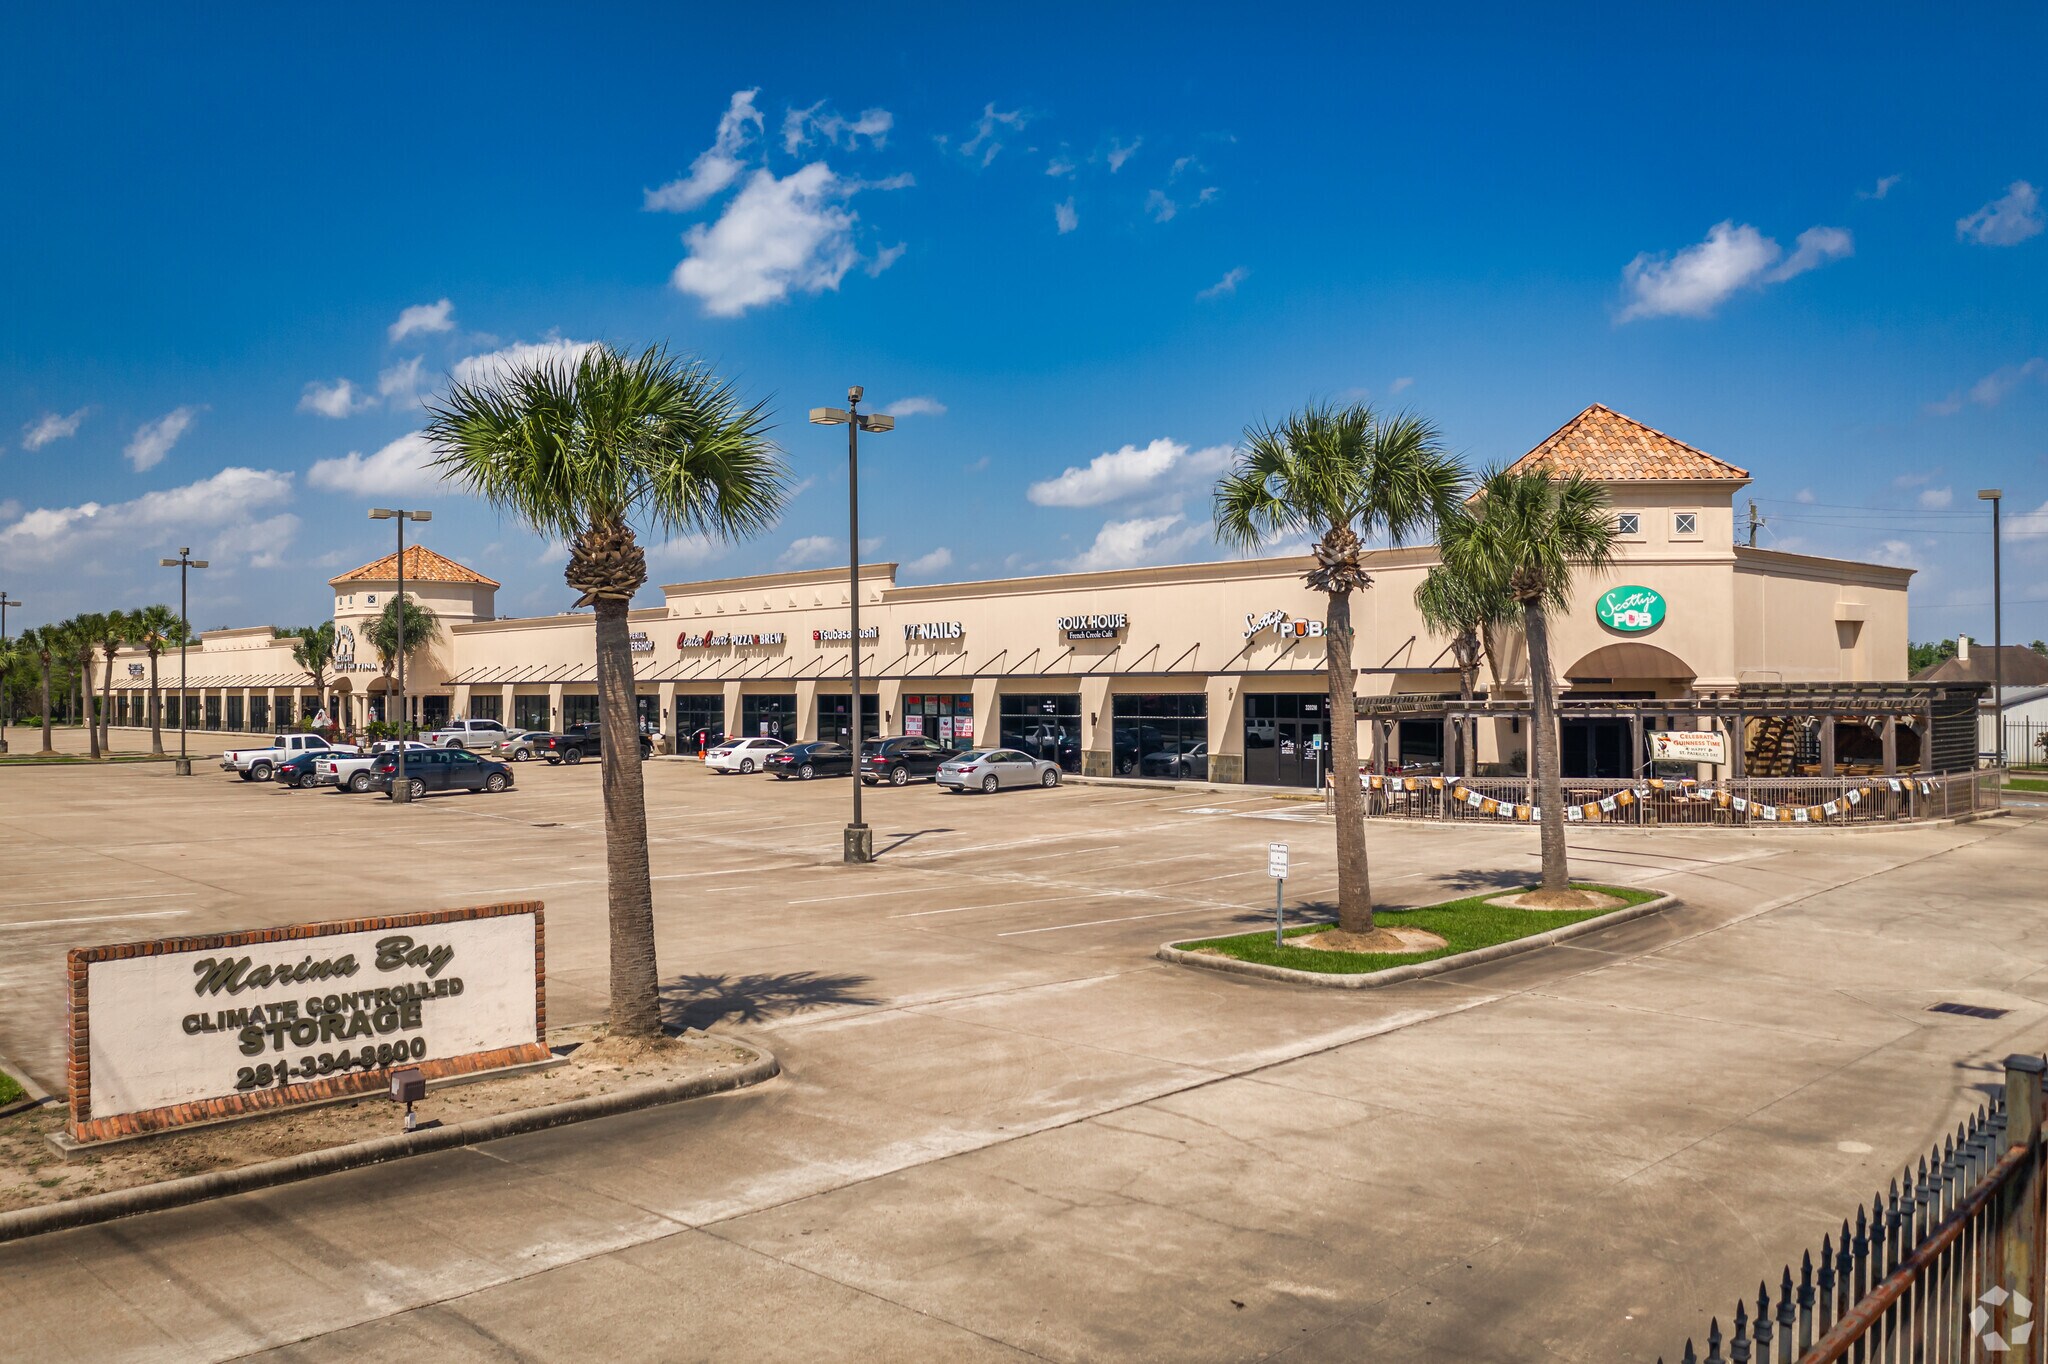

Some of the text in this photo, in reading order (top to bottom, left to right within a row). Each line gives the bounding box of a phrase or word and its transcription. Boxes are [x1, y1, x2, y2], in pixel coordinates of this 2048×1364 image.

[1601, 592, 1657, 617] Scotty's
[1056, 614, 1127, 630] ROUX HOUSE
[1242, 610, 1323, 639] Scotty's PUB
[1613, 610, 1652, 626] PUB
[677, 632, 704, 650] Center
[704, 630, 731, 648] Court
[731, 635, 753, 646] PIZZA
[760, 632, 784, 645] BREW
[819, 627, 878, 640] Tsubasa ushi
[922, 621, 963, 640] NAILS
[1069, 631, 1085, 639] French
[1085, 630, 1101, 639] Creole
[194, 935, 455, 998] Marina Bay
[182, 977, 465, 1035] CLIMATE CONTROLLED
[239, 1001, 424, 1057] STORAGE
[234, 1036, 427, 1090] 281-334-8800
